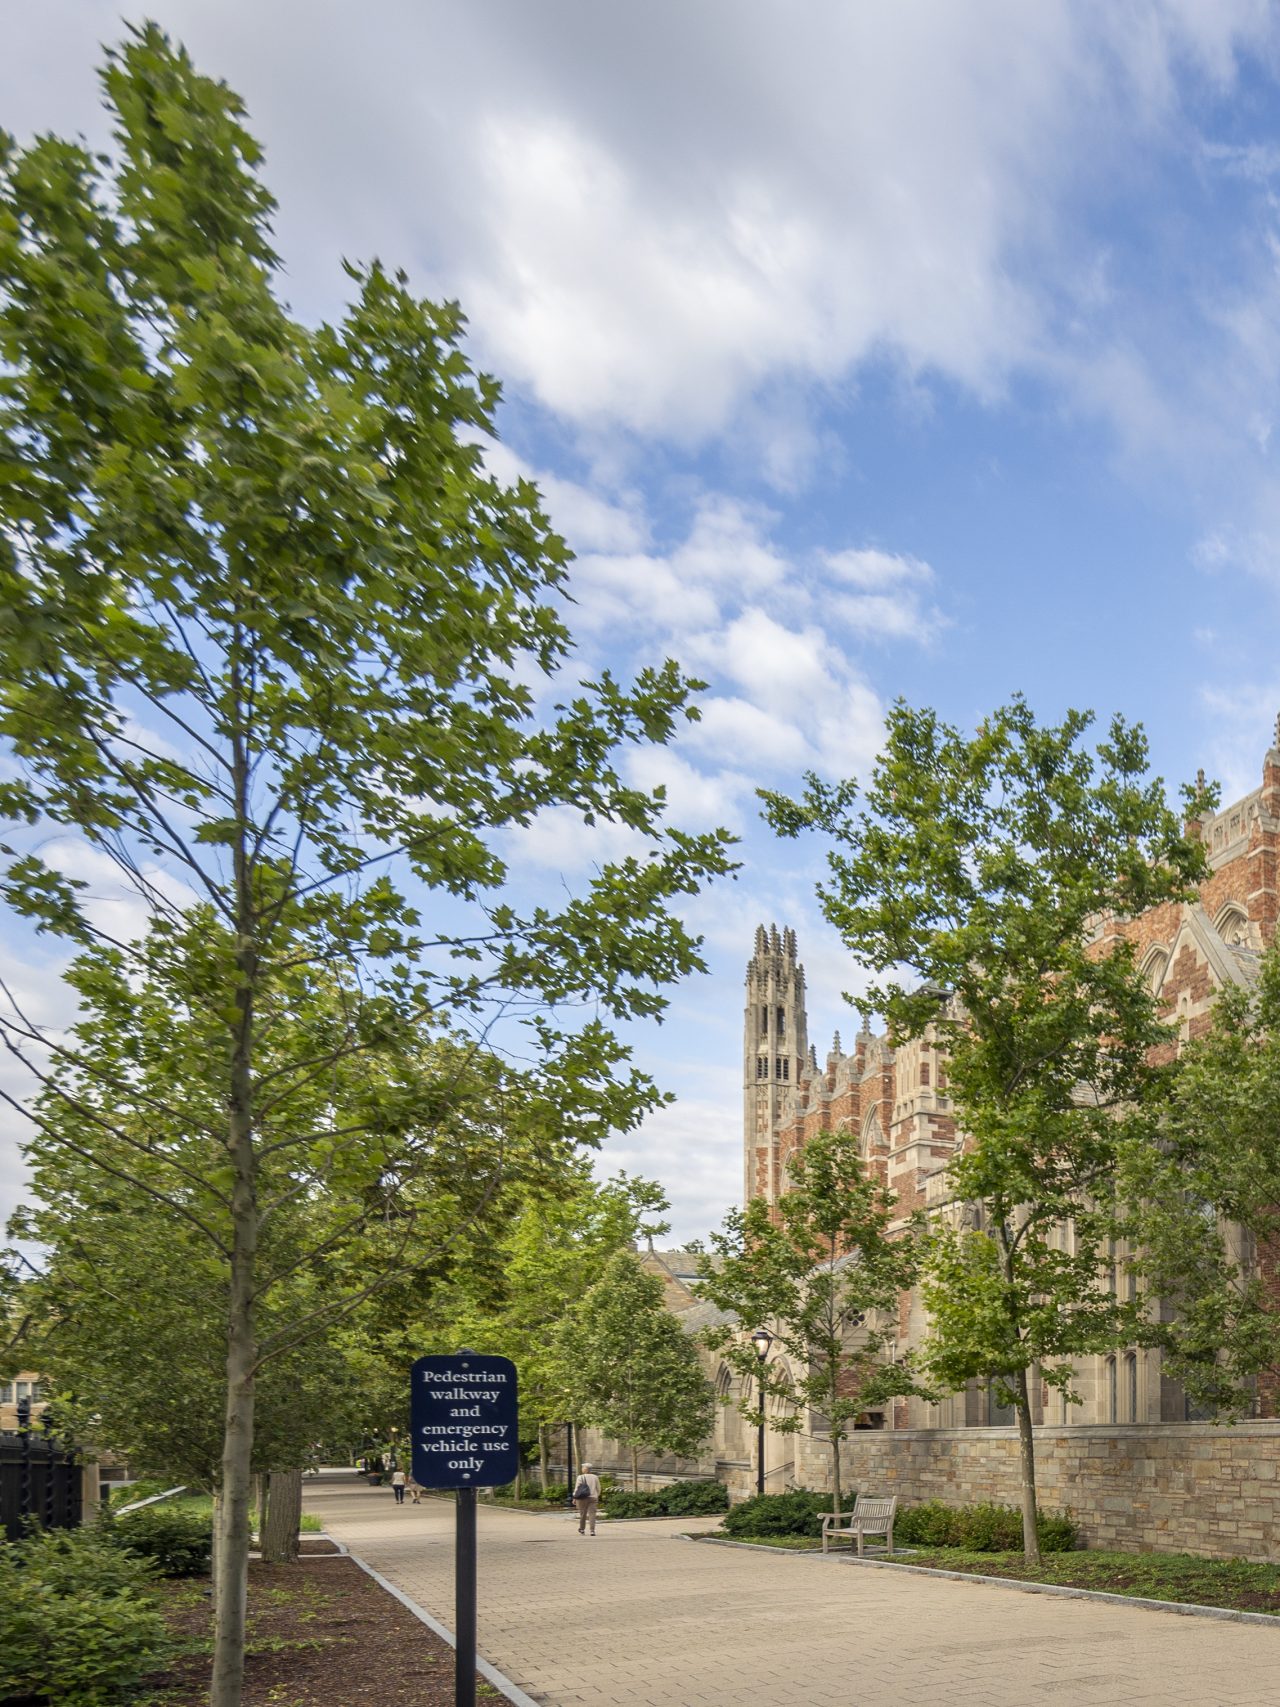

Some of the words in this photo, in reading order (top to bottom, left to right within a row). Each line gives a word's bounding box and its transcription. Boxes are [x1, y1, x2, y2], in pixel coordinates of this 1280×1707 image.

[422, 1371, 508, 1383] Pedestrian
[429, 1388, 501, 1402] walkway
[450, 1405, 481, 1417] and
[422, 1425, 509, 1438] emergency
[420, 1440, 478, 1452] vehicle
[482, 1441, 510, 1451] use
[448, 1457, 484, 1472] only
